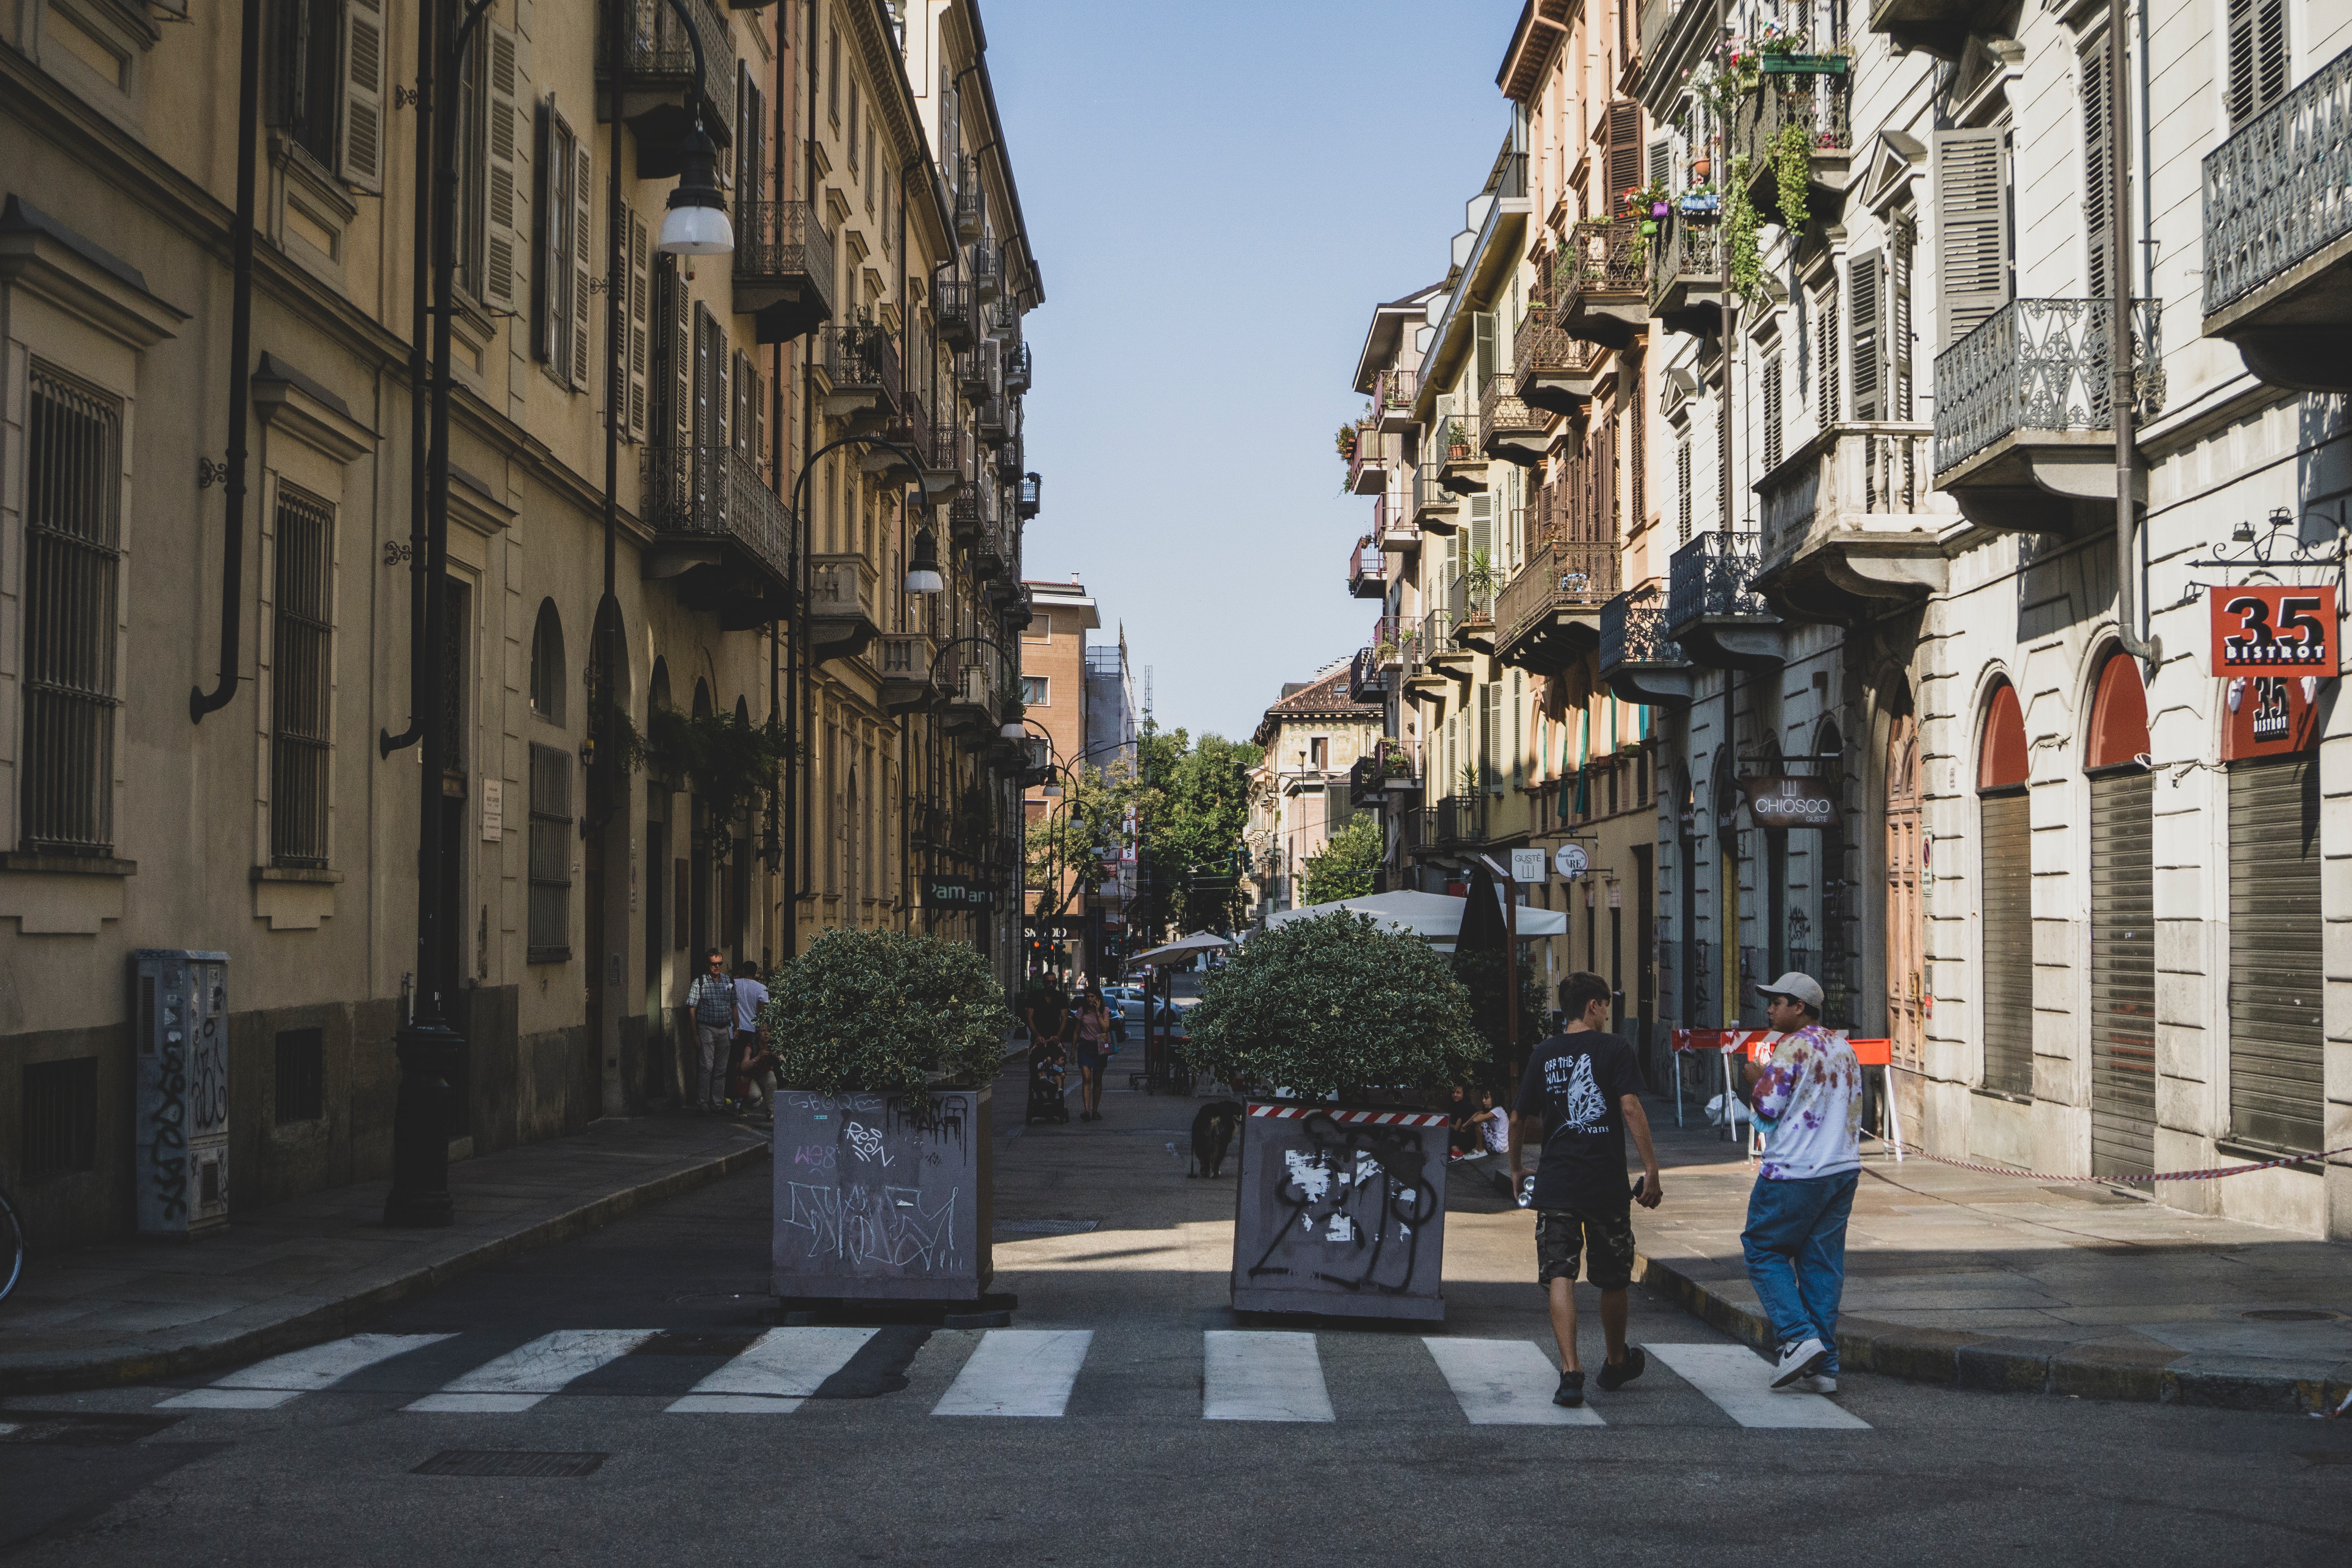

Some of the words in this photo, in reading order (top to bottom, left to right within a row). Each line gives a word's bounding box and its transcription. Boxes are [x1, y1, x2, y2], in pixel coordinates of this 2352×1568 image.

[2223, 596, 2325, 647] 35
[2226, 645, 2325, 659] BISTROT
[2253, 677, 2289, 719] 35
[2253, 716, 2287, 733] BISTROT
[1755, 799, 1830, 813] CHIOSCO
[1515, 853, 1542, 862] GUSTÈ
[1570, 860, 1581, 868] RE
[1545, 1058, 1556, 1073] OFF
[1558, 1055, 1574, 1069] THE
[1546, 1070, 1568, 1084] WALL
[1587, 1125, 1610, 1134] vans
